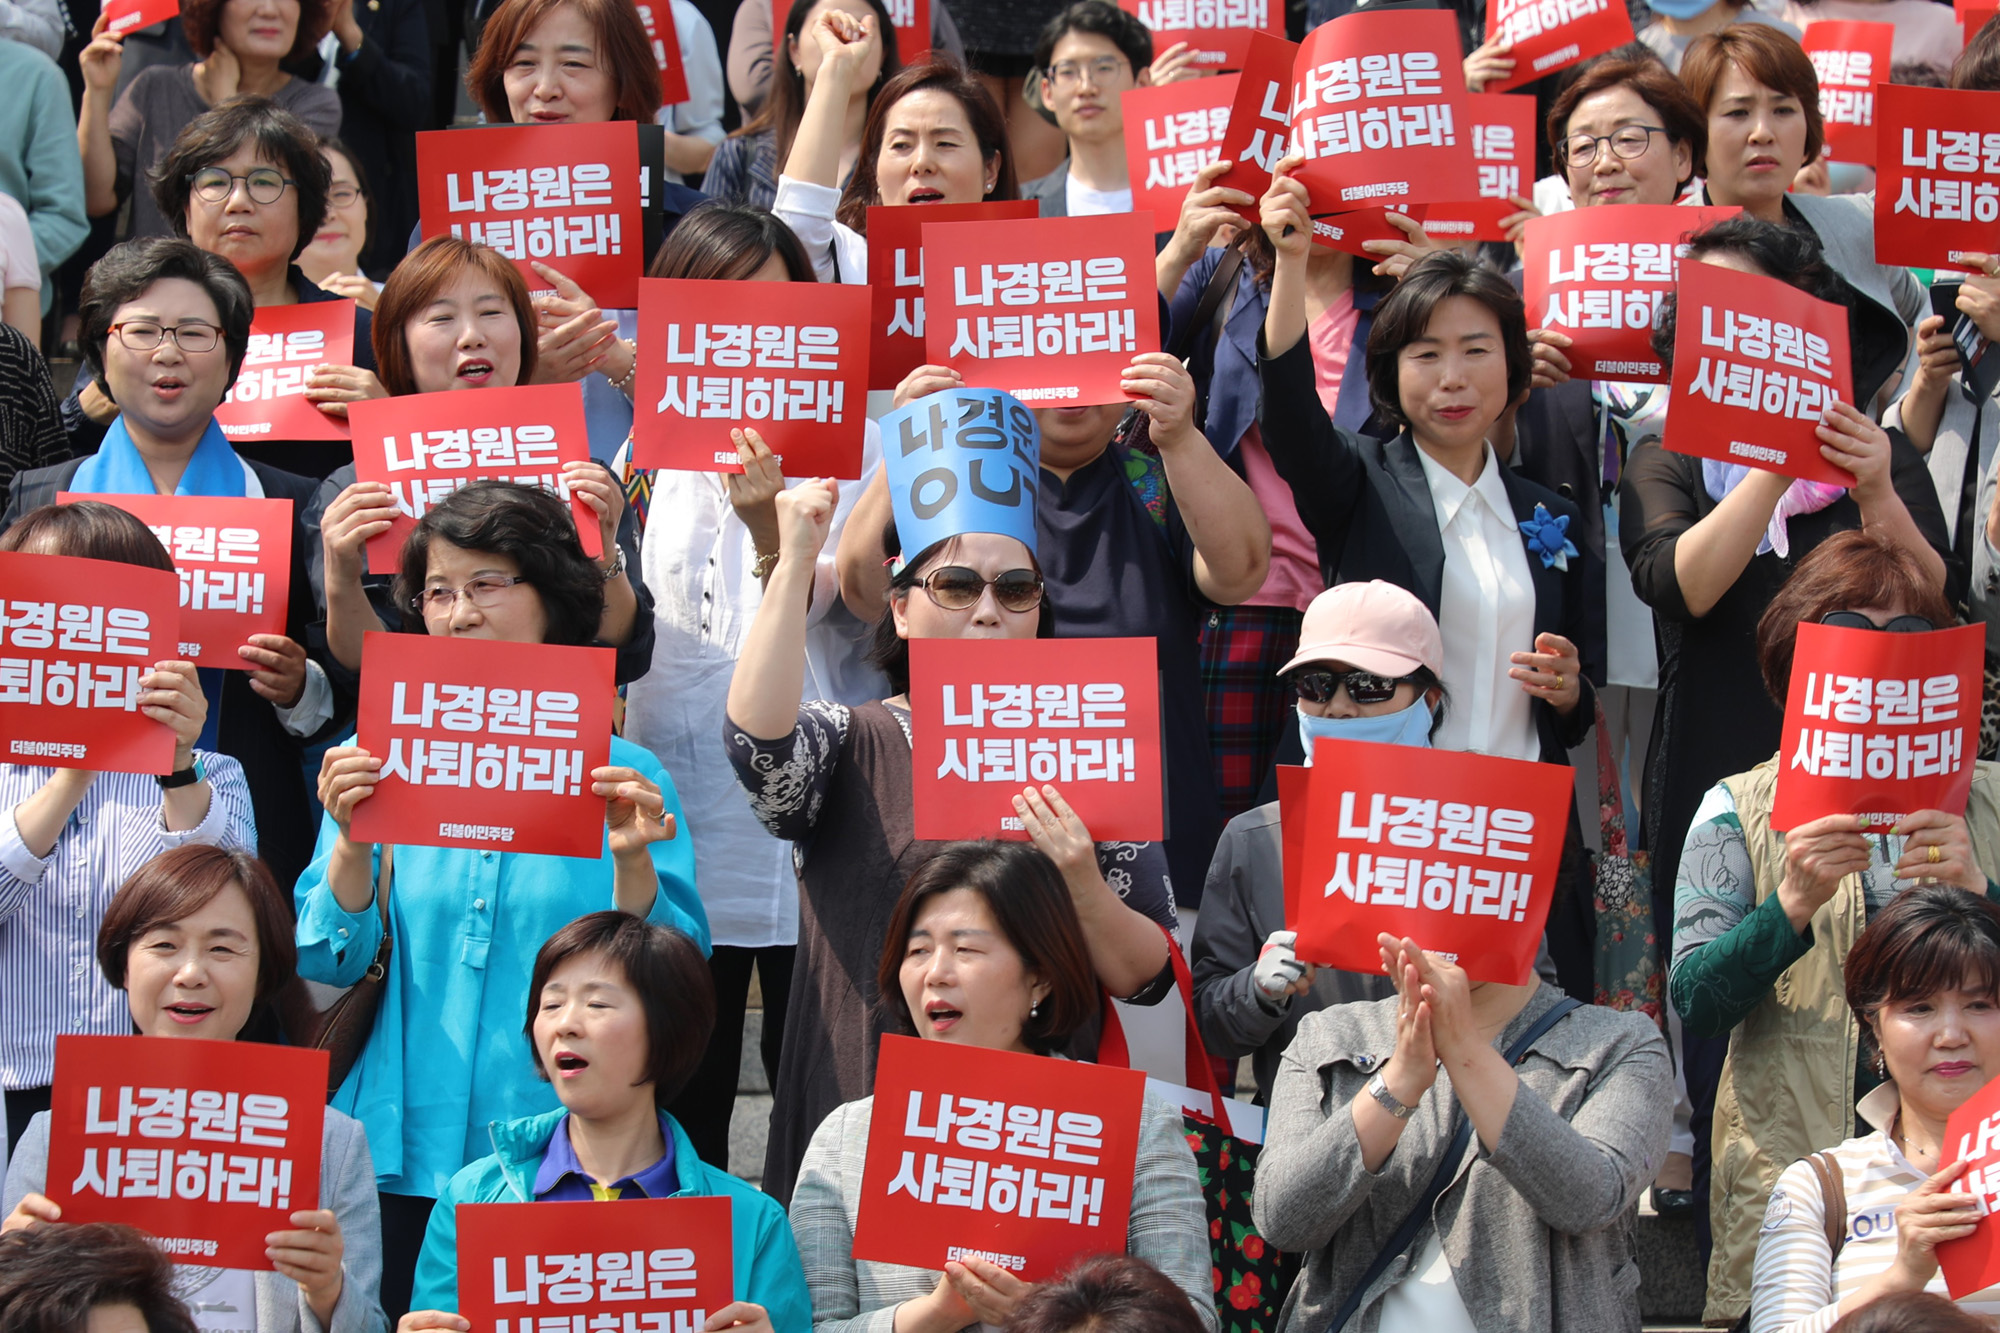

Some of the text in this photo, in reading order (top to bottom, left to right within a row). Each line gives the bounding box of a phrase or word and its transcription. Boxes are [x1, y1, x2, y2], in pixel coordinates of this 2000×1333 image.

[1292, 52, 1443, 119] 나경원은
[447, 163, 612, 213] 나경원은
[1341, 182, 1410, 202] 더불어민주당
[953, 256, 1127, 307] 나경원은
[950, 309, 1136, 360] 사퇴하라!
[1541, 289, 1672, 331] 사퇴하
[666, 323, 839, 371] 나경원은
[1702, 305, 1833, 380] 나경원은
[1594, 360, 1662, 377] 더불어민주당
[656, 375, 845, 424] 사퇴하라!
[383, 425, 559, 472] 나경원은
[1728, 441, 1788, 465] 더불어민주당
[391, 681, 580, 739] 나경원은
[942, 683, 1126, 728] 나경원은
[1803, 672, 1960, 725] 나경원은
[10, 740, 87, 760] 더불어민주당
[379, 738, 584, 796] 사퇴하라!
[936, 738, 1136, 782] 사퇴하라!
[1791, 727, 1963, 780] 사퇴하라!
[439, 822, 515, 842] 더불어민주당
[1337, 791, 1535, 862] 나경원은
[1324, 852, 1534, 922] 사퇴하라!
[85, 1086, 289, 1148] 나경원은
[904, 1090, 1103, 1166] 나경원은
[72, 1147, 293, 1210] 사퇴하라!
[887, 1151, 1105, 1227] 사퇴하라!
[493, 1248, 698, 1305] 나경원은
